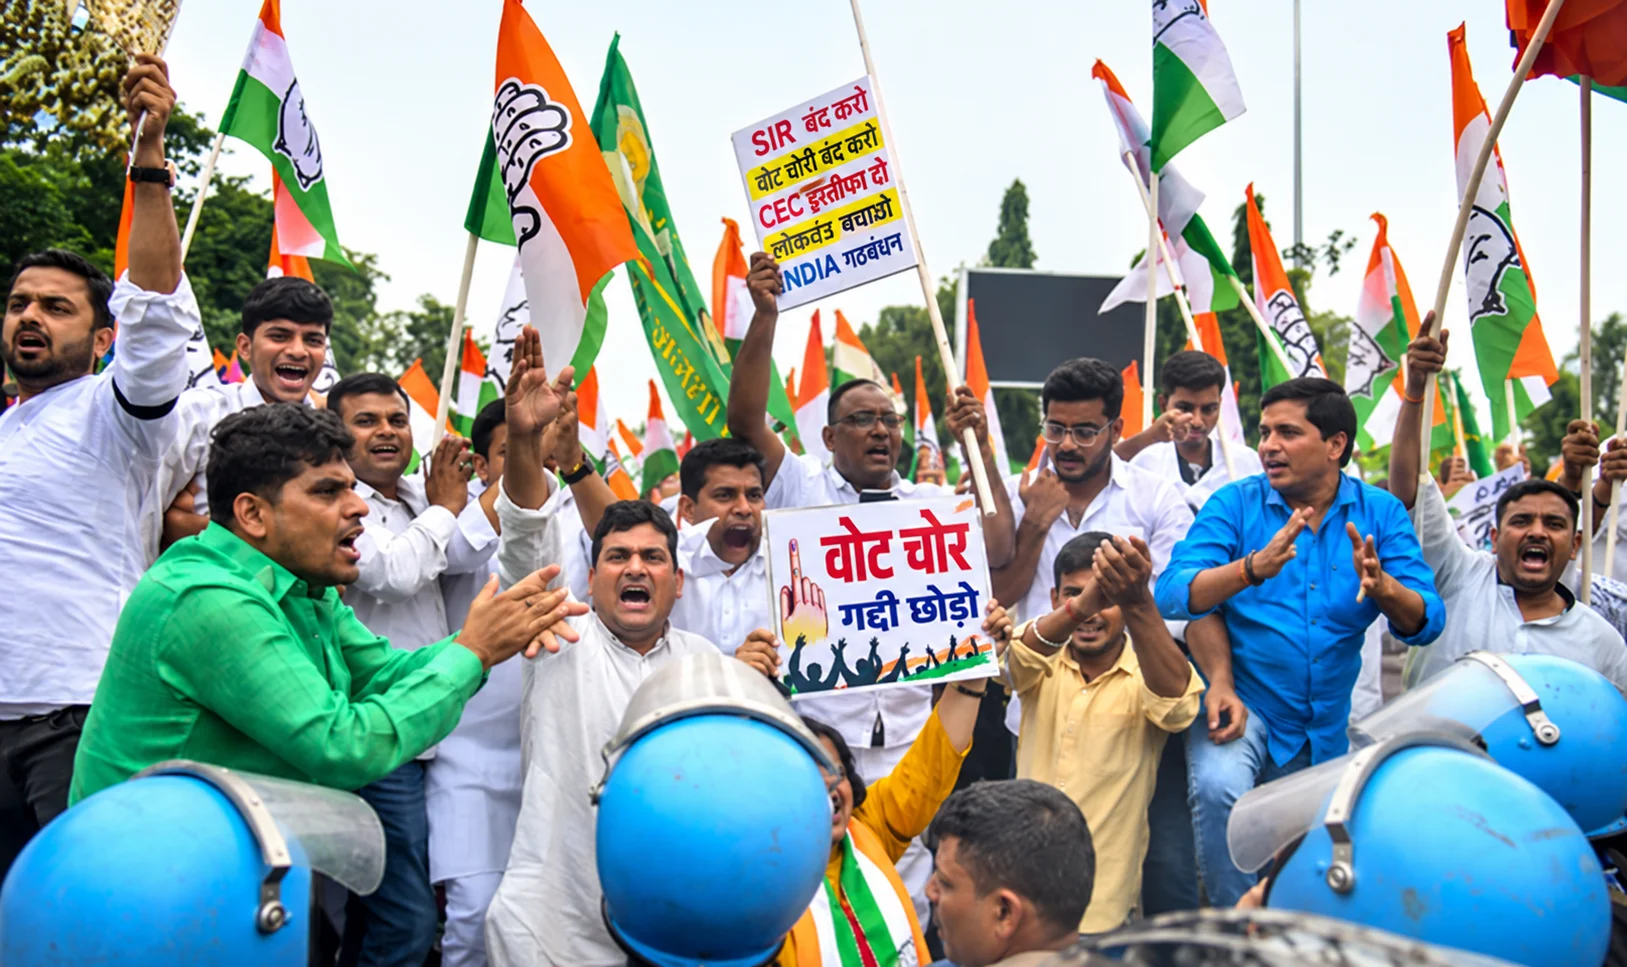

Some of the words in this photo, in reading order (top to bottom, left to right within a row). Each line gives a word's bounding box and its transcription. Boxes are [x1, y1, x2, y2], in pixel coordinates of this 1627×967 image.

[751, 119, 797, 157] SIR
[801, 106, 832, 133] बंद
[831, 85, 869, 115] करो
[754, 167, 784, 192] वोट
[783, 147, 818, 180] चोरी
[818, 140, 845, 165] बंद
[844, 122, 879, 154] करो
[758, 193, 804, 229] CEC
[868, 156, 890, 185] दो
[842, 232, 904, 268] गठबंधन
[819, 516, 895, 583] वोट
[899, 508, 973, 575] चोर
[838, 589, 900, 632] गद्दी
[906, 581, 980, 628] छोड़ो
